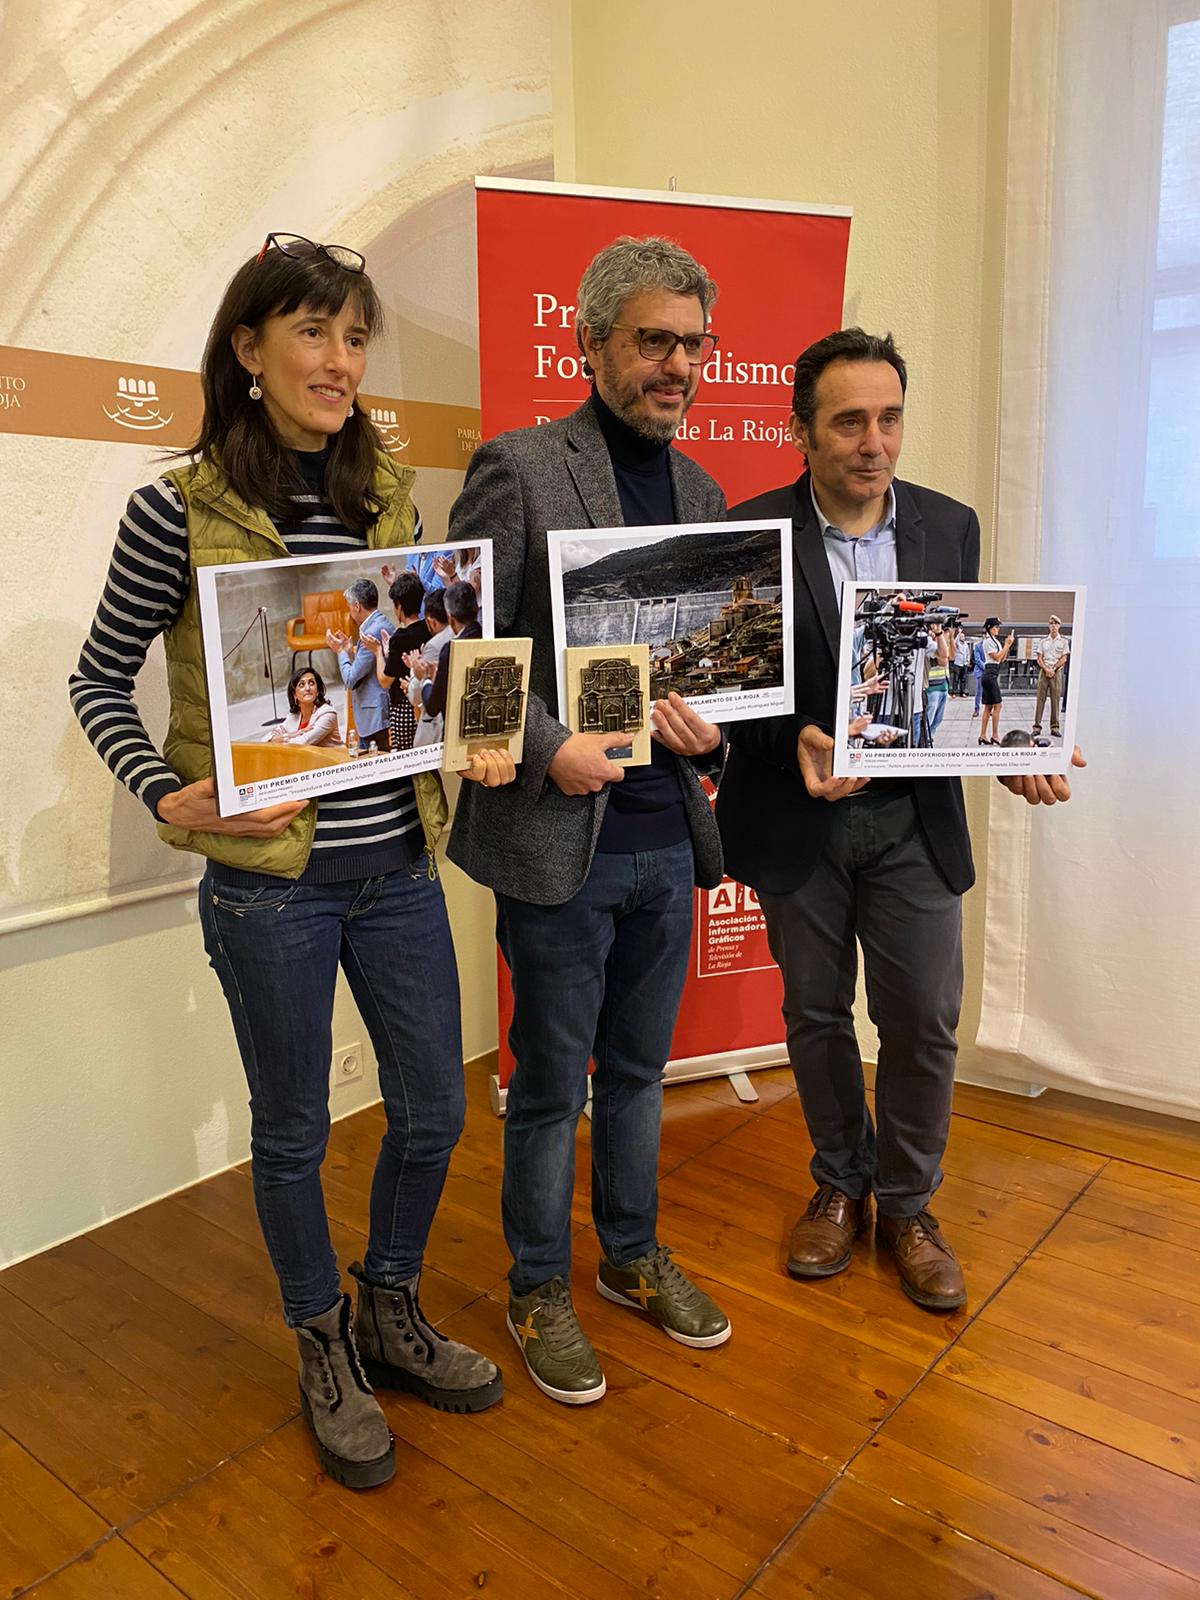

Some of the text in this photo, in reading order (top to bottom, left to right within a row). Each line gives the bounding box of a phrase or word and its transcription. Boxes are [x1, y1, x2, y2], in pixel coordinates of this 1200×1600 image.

[533, 293, 580, 328] Pr
[675, 418, 701, 441] de
[708, 419, 735, 441] La
[270, 777, 299, 787] PREMIO
[312, 760, 374, 779] FOTOPERIODISMO
[375, 750, 419, 764] PARLAMENTO
[708, 914, 757, 927] Asociación
[708, 934, 745, 945] Gráficos
[716, 944, 735, 952] Prensa
[708, 961, 732, 970] La Rioja
